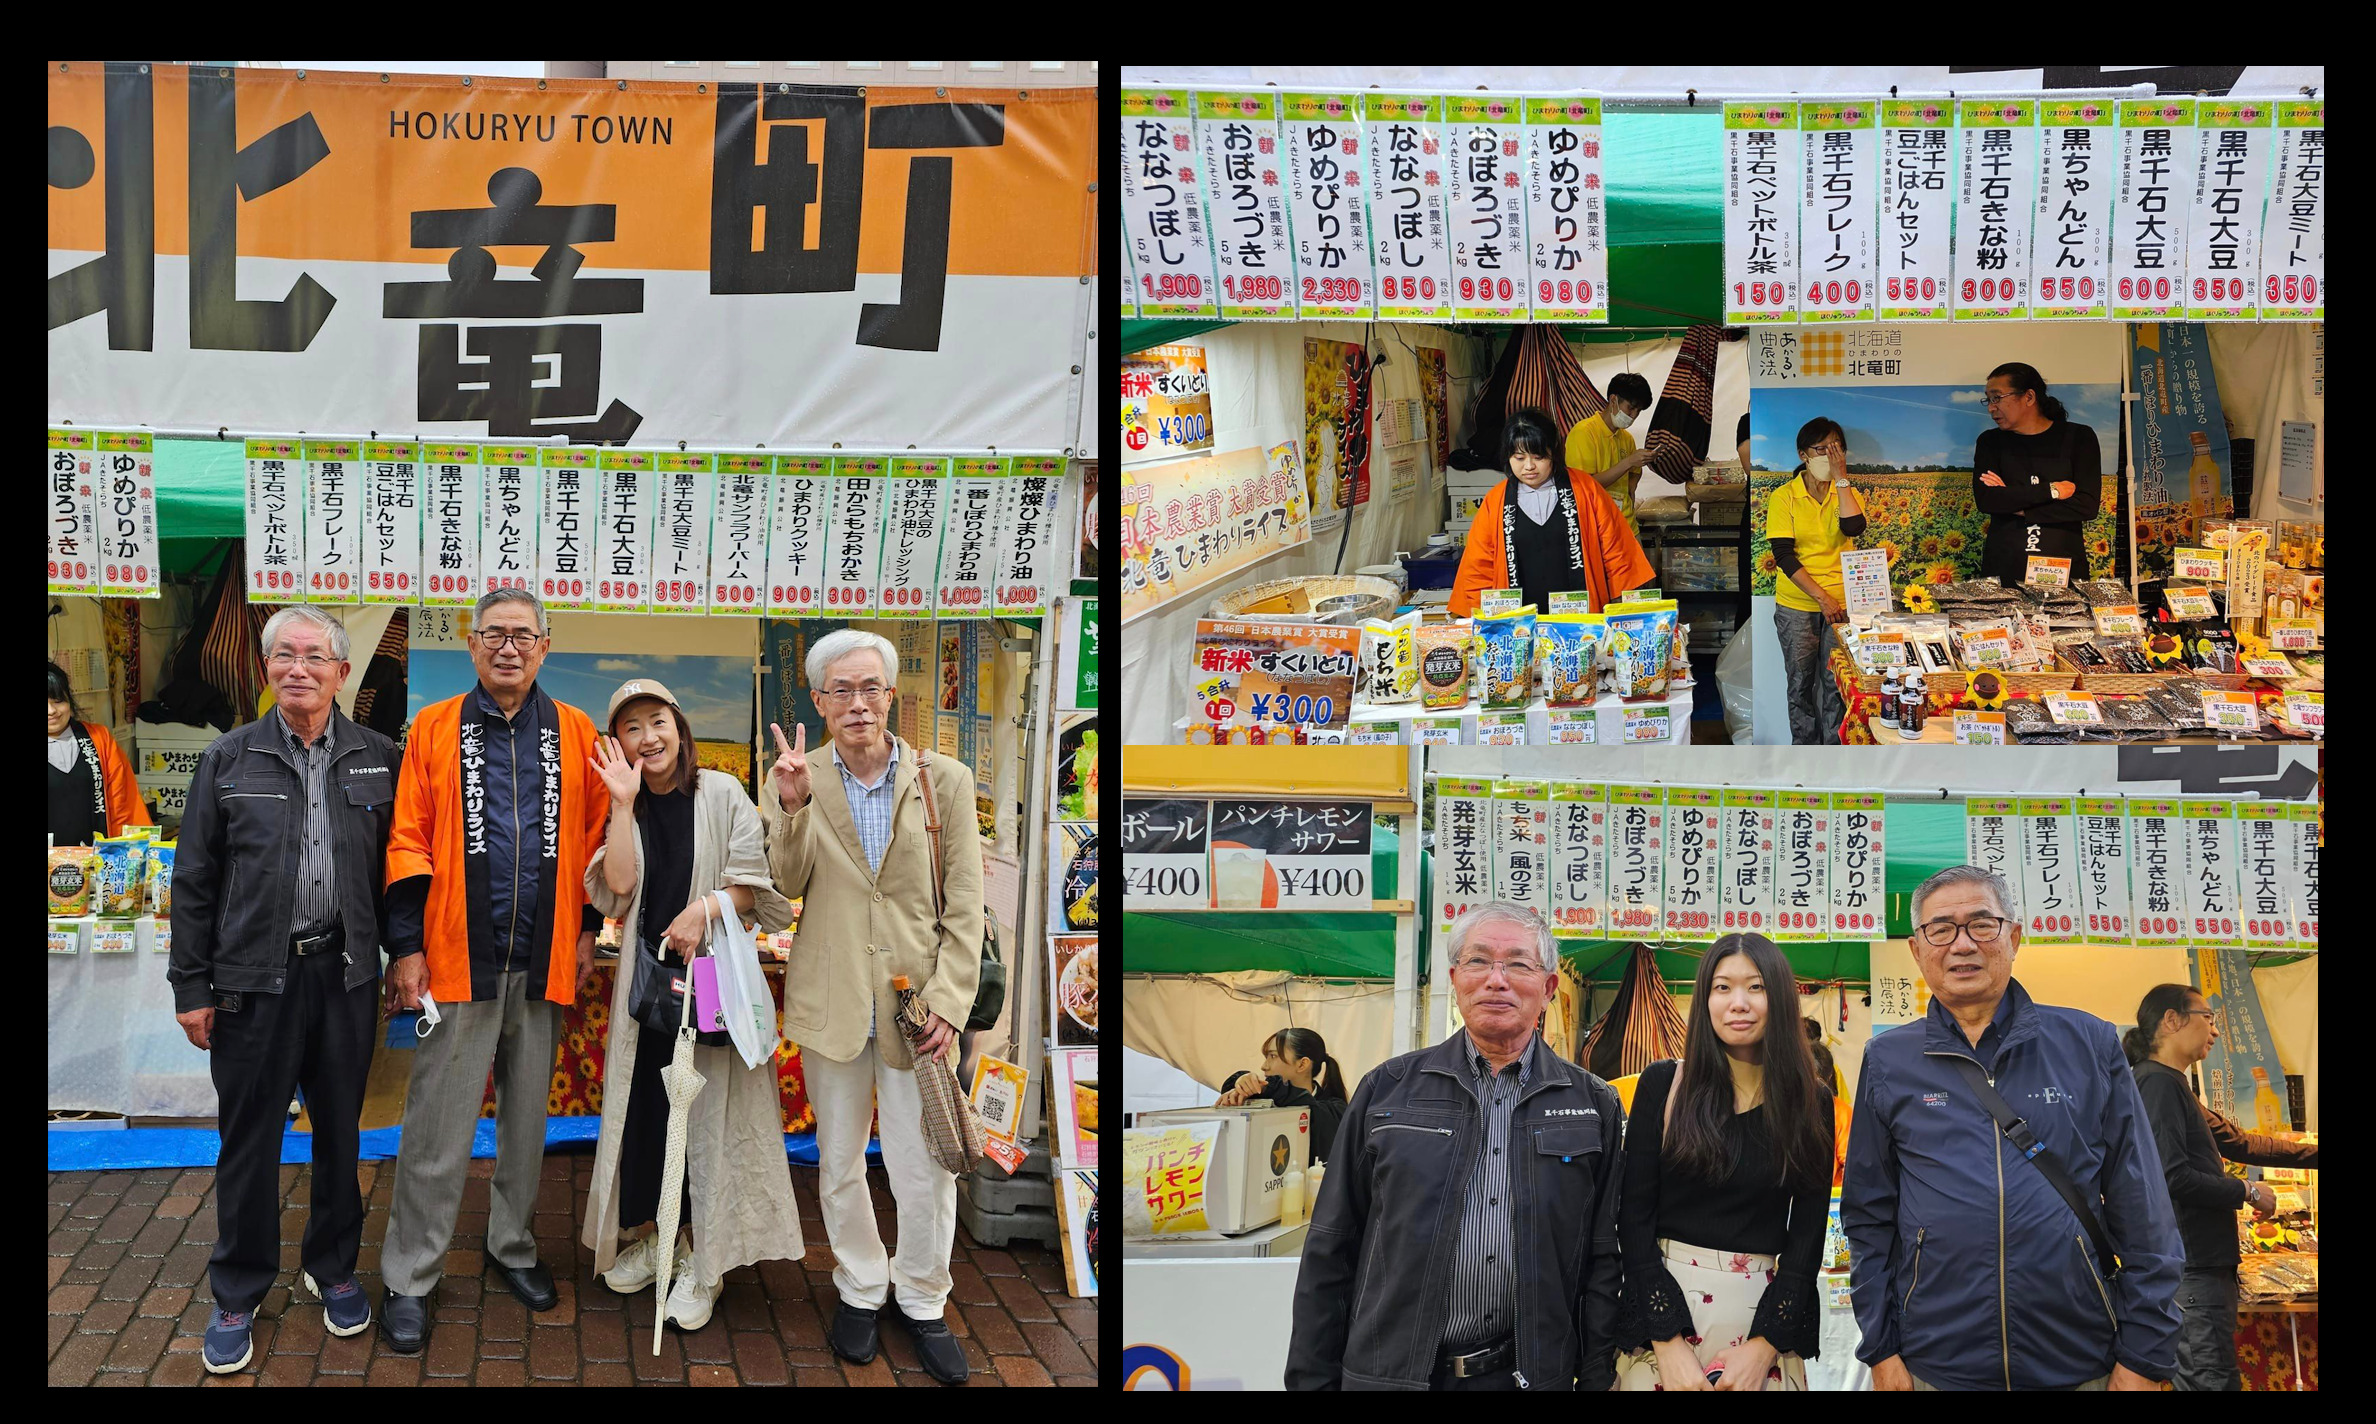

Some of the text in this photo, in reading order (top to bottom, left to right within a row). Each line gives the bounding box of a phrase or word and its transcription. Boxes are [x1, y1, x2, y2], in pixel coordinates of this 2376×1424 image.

[388, 109, 674, 146] HOKURYU TOWN
[1922, 130, 1946, 189] 黒千石
[1136, 120, 1184, 265] ななつぼし
[1223, 123, 1266, 267] おぼろづき
[1307, 125, 1347, 268] ゆめぴりか
[1389, 124, 1423, 267] ななつぼし
[1469, 127, 1502, 268] おぼろづき
[1549, 128, 1581, 270] ゆめぴりか
[1747, 132, 1777, 273] 黒千石ペットボトル茶
[1823, 132, 1853, 271] 黒千石フレーク
[1897, 130, 1921, 269] 豆ごはんセット
[1977, 130, 2012, 270] 黒千石きな粉
[2056, 129, 2091, 268] 黒ちゃんどん
[2134, 130, 2171, 268] 黒千石大豆
[2208, 131, 2244, 269] 黒千石大豆
[2288, 130, 2324, 266] 黒千石大豆ミート
[1427, 195, 1443, 251] 低農薬米
[1506, 198, 1521, 253] 低農薬米
[1586, 197, 1601, 252] 低農薬米
[1141, 274, 1203, 300] 1,900
[1223, 275, 1283, 301] 1,980
[1302, 276, 1362, 303] 2,330
[1382, 276, 1436, 301] 850
[1459, 277, 1514, 302] 930
[1538, 279, 1592, 305] 980
[1734, 282, 1785, 306] 150
[1807, 280, 1861, 304] 400
[1887, 277, 1936, 301] 550
[1961, 278, 2015, 301] 300
[2041, 276, 2094, 300] 550
[2118, 277, 2171, 300] 600
[2193, 277, 2244, 301] 350
[2266, 275, 2316, 302] 350
[1780, 332, 1797, 379] あかるい
[1849, 330, 1902, 347] 北海道
[1849, 349, 1902, 357] ひまわりの
[1158, 372, 1209, 395] すくいとり
[1849, 360, 1902, 376] 北竜町
[1157, 413, 1206, 446] ¥300
[54, 452, 78, 555] おぼろづき
[396, 464, 414, 507] 黒千石
[1227, 470, 1289, 518] 大賞受賞
[114, 454, 139, 558] ゆめぴりか
[262, 461, 287, 565] 黒千石ペットボトル茶
[322, 463, 343, 565] 黒千石フレーク
[376, 463, 394, 566] 豆ごはんセット
[440, 466, 462, 568] 黒千石きな粉
[498, 468, 520, 570] 黒ちゃんどん
[556, 470, 579, 572] 黒千石大豆
[612, 473, 637, 575] 黒千石大豆
[672, 474, 693, 574] 黒千石大豆ミート
[914, 479, 937, 538] 黒千石大豆の
[728, 475, 754, 578] 北竜サンフラワーバーム
[789, 479, 813, 576] ひまわりクッキー
[840, 478, 870, 581] 田からもちおかき
[894, 479, 917, 586] ひまわり油ドレッシング
[955, 483, 991, 580] 一番しぼりひまわり油
[1009, 477, 1049, 579] 燦燦ひまわり油
[1558, 488, 1584, 570] 北竜ひまわりライス
[1503, 503, 1519, 588] 北竜ひまわりライス
[2180, 558, 2218, 566] ひまわりクッキー
[46, 560, 88, 581] 930
[106, 565, 148, 584] 980
[254, 571, 295, 590] 150
[310, 572, 351, 591] 400
[368, 571, 410, 592] 550
[429, 574, 469, 594] 300
[542, 578, 584, 598] 600
[2186, 566, 2210, 578] 900
[599, 580, 640, 600] 350
[656, 580, 697, 602] 350
[716, 585, 756, 604] 500
[772, 585, 812, 605] 900
[827, 586, 868, 606] 300
[882, 587, 923, 607] 600
[940, 586, 983, 606] 1,000
[996, 586, 1038, 606] 1,000
[1213, 623, 1349, 640] 第46回 日本農業賞 大賞受賞
[1200, 647, 1354, 677] 新米 すくいとり
[1375, 641, 1399, 697] もち米
[1425, 660, 1461, 674] 発芽玄米
[1499, 635, 1514, 683] 北海道
[1565, 639, 1580, 683] 北海道
[1642, 630, 1656, 677] 北海道
[1208, 704, 1233, 716] 1回
[1251, 692, 1334, 725] ¥300
[2057, 701, 2090, 710] 黒千石大豆
[2212, 703, 2248, 714] 黒千石大豆
[460, 722, 488, 855] 北竜ひまわりライス
[540, 727, 562, 859] 北竜ひまわりライス
[1220, 805, 1365, 828] パンチレモン
[1290, 832, 1360, 854] サワー
[1453, 801, 1477, 895] 発芽玄米
[1567, 803, 1588, 901] ななつぼし
[1624, 805, 1647, 905] おぼろづき
[2105, 818, 2121, 856] 黒千石
[1682, 808, 1703, 905] ゆめぴりか
[1737, 809, 1759, 905] ななつぼし
[1791, 811, 1812, 906] おぼろづき
[1847, 812, 1867, 907] ゆめぴりか
[2036, 817, 2061, 909] 黒千石フレーク
[2088, 817, 2107, 909] 豆ごはんセット
[2146, 818, 2169, 912] 黒千石きな粉
[2198, 820, 2223, 912] 黒ちゃんどん
[2254, 821, 2278, 914] 黒千石大豆
[113, 856, 127, 896] 北海道
[1281, 867, 1364, 897] ¥400
[1554, 906, 1597, 926] 1,900
[1610, 909, 1654, 928] 1,980
[1666, 910, 1710, 930] 2,330
[1723, 910, 1763, 929] 850
[1778, 911, 1818, 930] 930
[1834, 913, 1875, 930] 980
[2031, 914, 2073, 933] 400
[2088, 913, 2123, 933] 550
[2139, 916, 2179, 935] 300
[2194, 917, 2234, 936] 550
[2247, 919, 2285, 937] 600
[1145, 1142, 1206, 1174] パンチ
[1146, 1165, 1205, 1196] レモン
[1147, 1190, 1204, 1217] サワー
